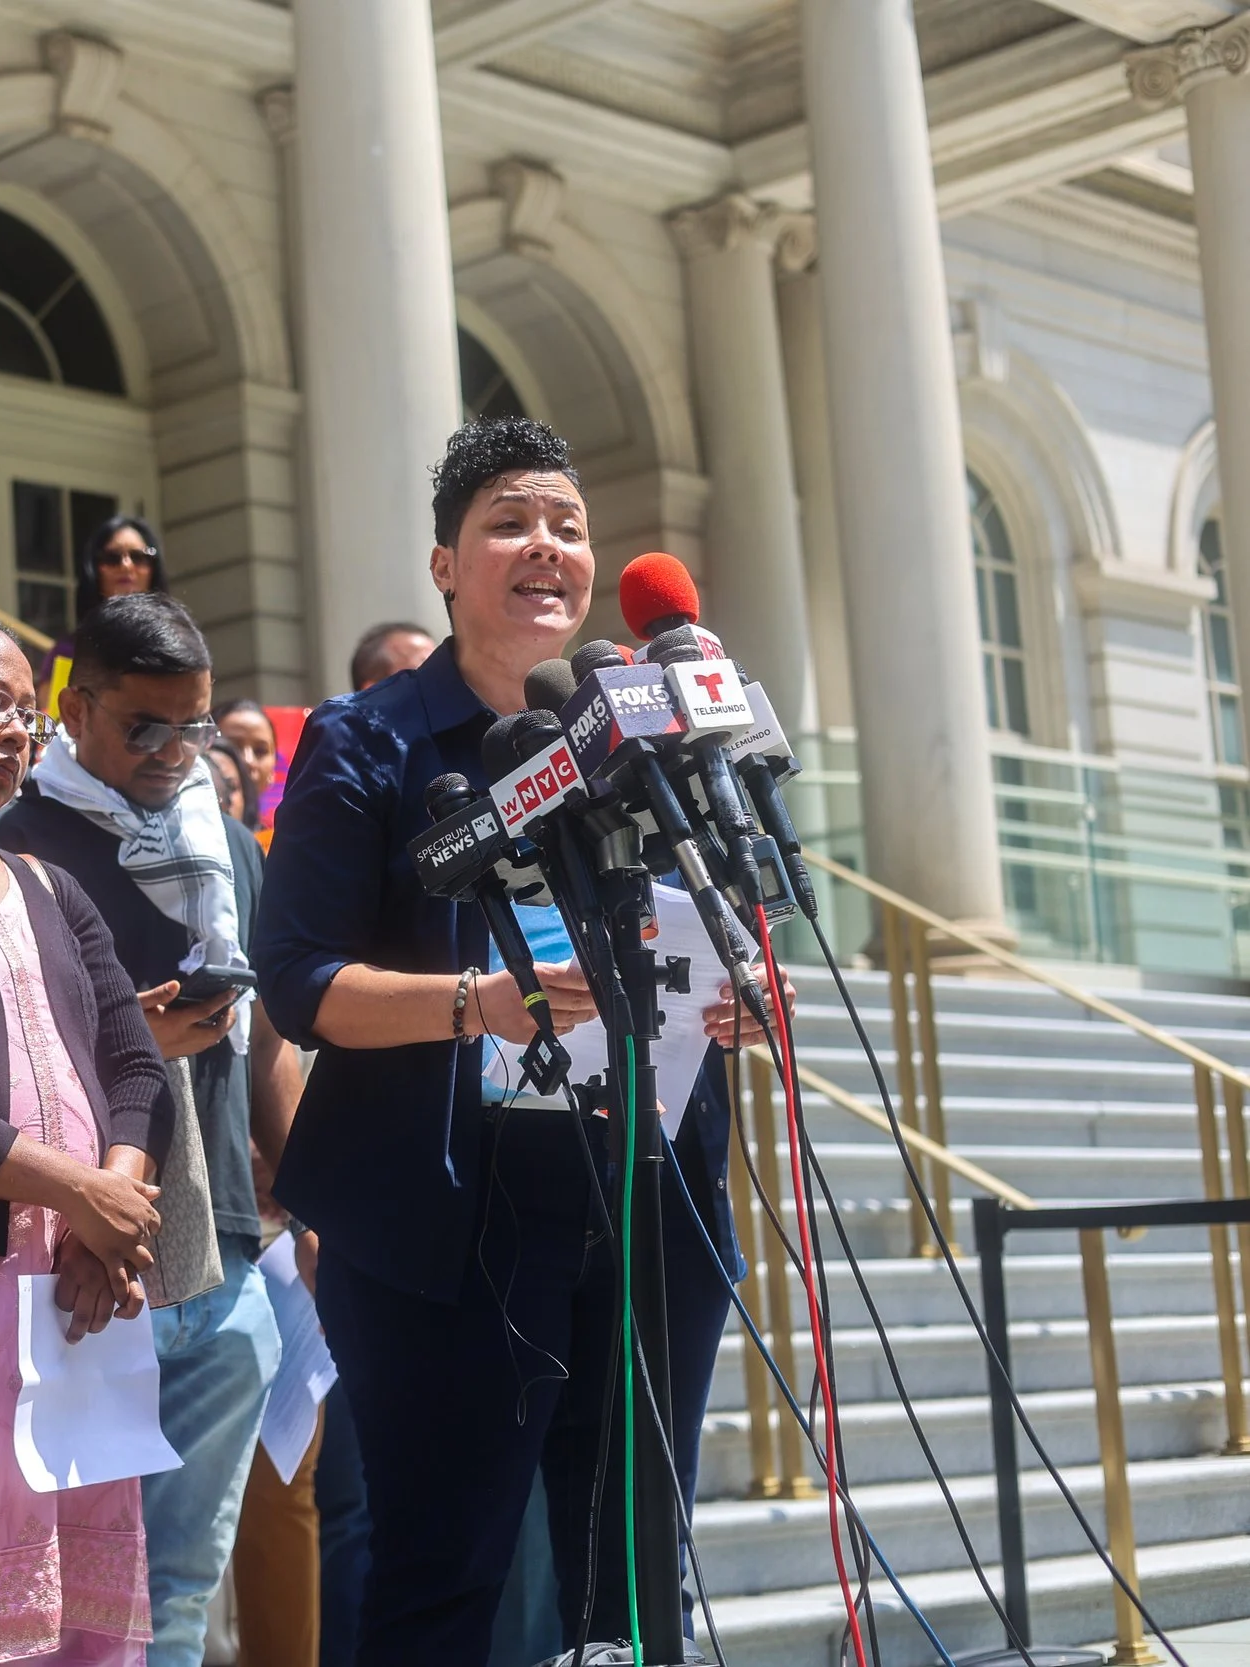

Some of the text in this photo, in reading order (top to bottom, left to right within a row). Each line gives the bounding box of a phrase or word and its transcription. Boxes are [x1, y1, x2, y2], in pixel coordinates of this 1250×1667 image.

[616, 703, 675, 715] NEW YORK
[694, 704, 746, 716] TELEMUNDO
[577, 713, 611, 754] NEW YORK
[729, 728, 771, 751] LEMUNDO
[500, 760, 572, 817] WNYC
[416, 824, 470, 863] SPECTRUM
[431, 834, 475, 868] NEWS
